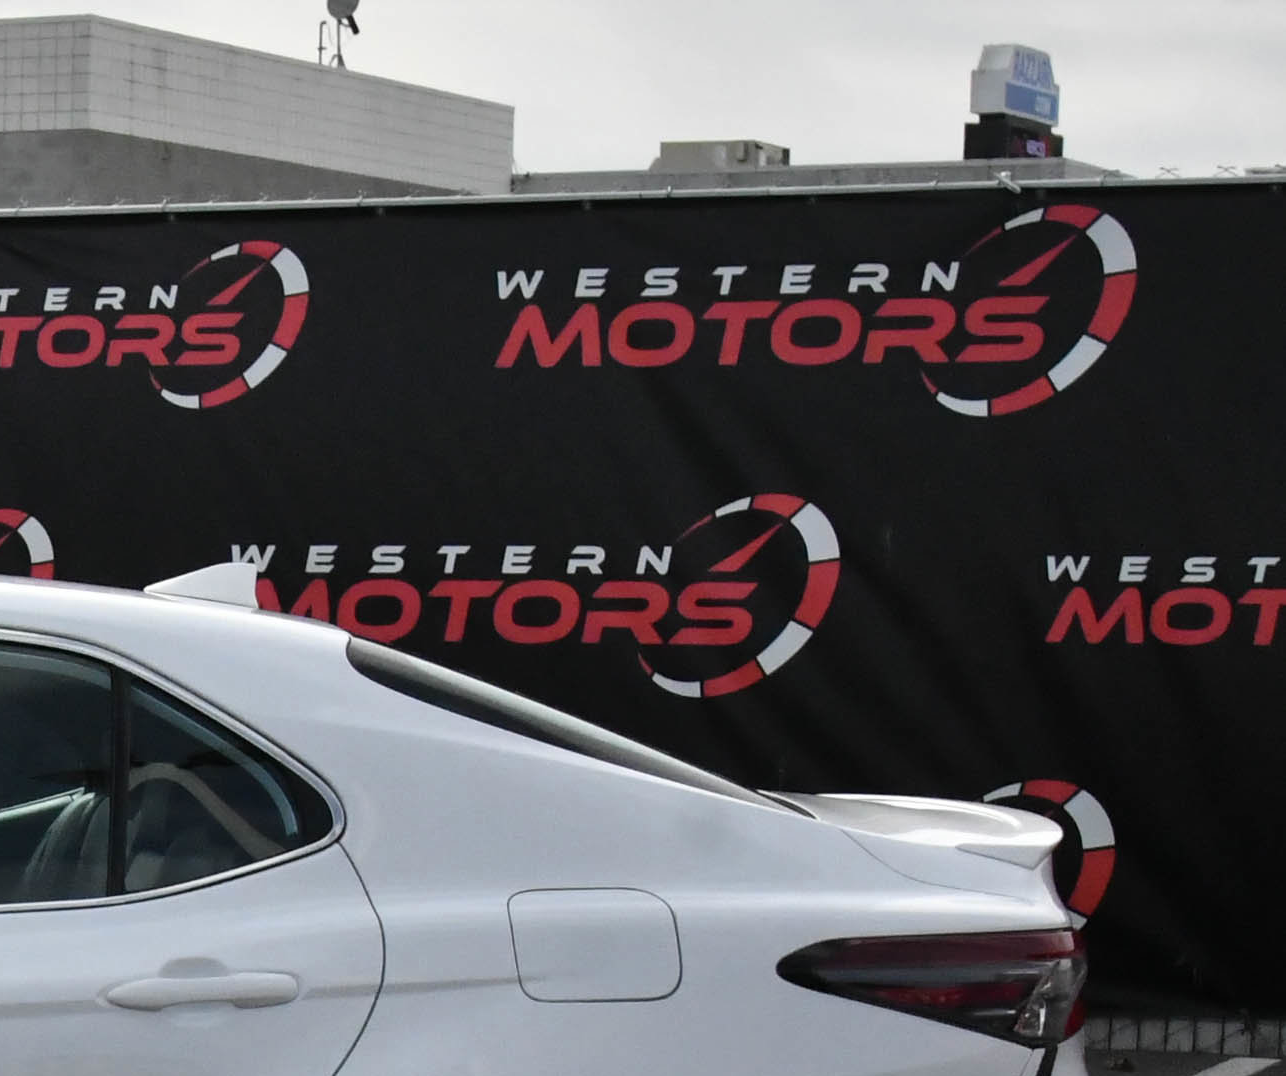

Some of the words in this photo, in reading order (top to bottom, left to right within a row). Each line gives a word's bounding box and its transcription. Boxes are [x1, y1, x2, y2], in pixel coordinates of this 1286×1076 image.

[497, 261, 960, 300] WESTERN
[495, 295, 1050, 369] MOTORS
[230, 543, 674, 575] WESTERN
[1046, 555, 1282, 583] WEST
